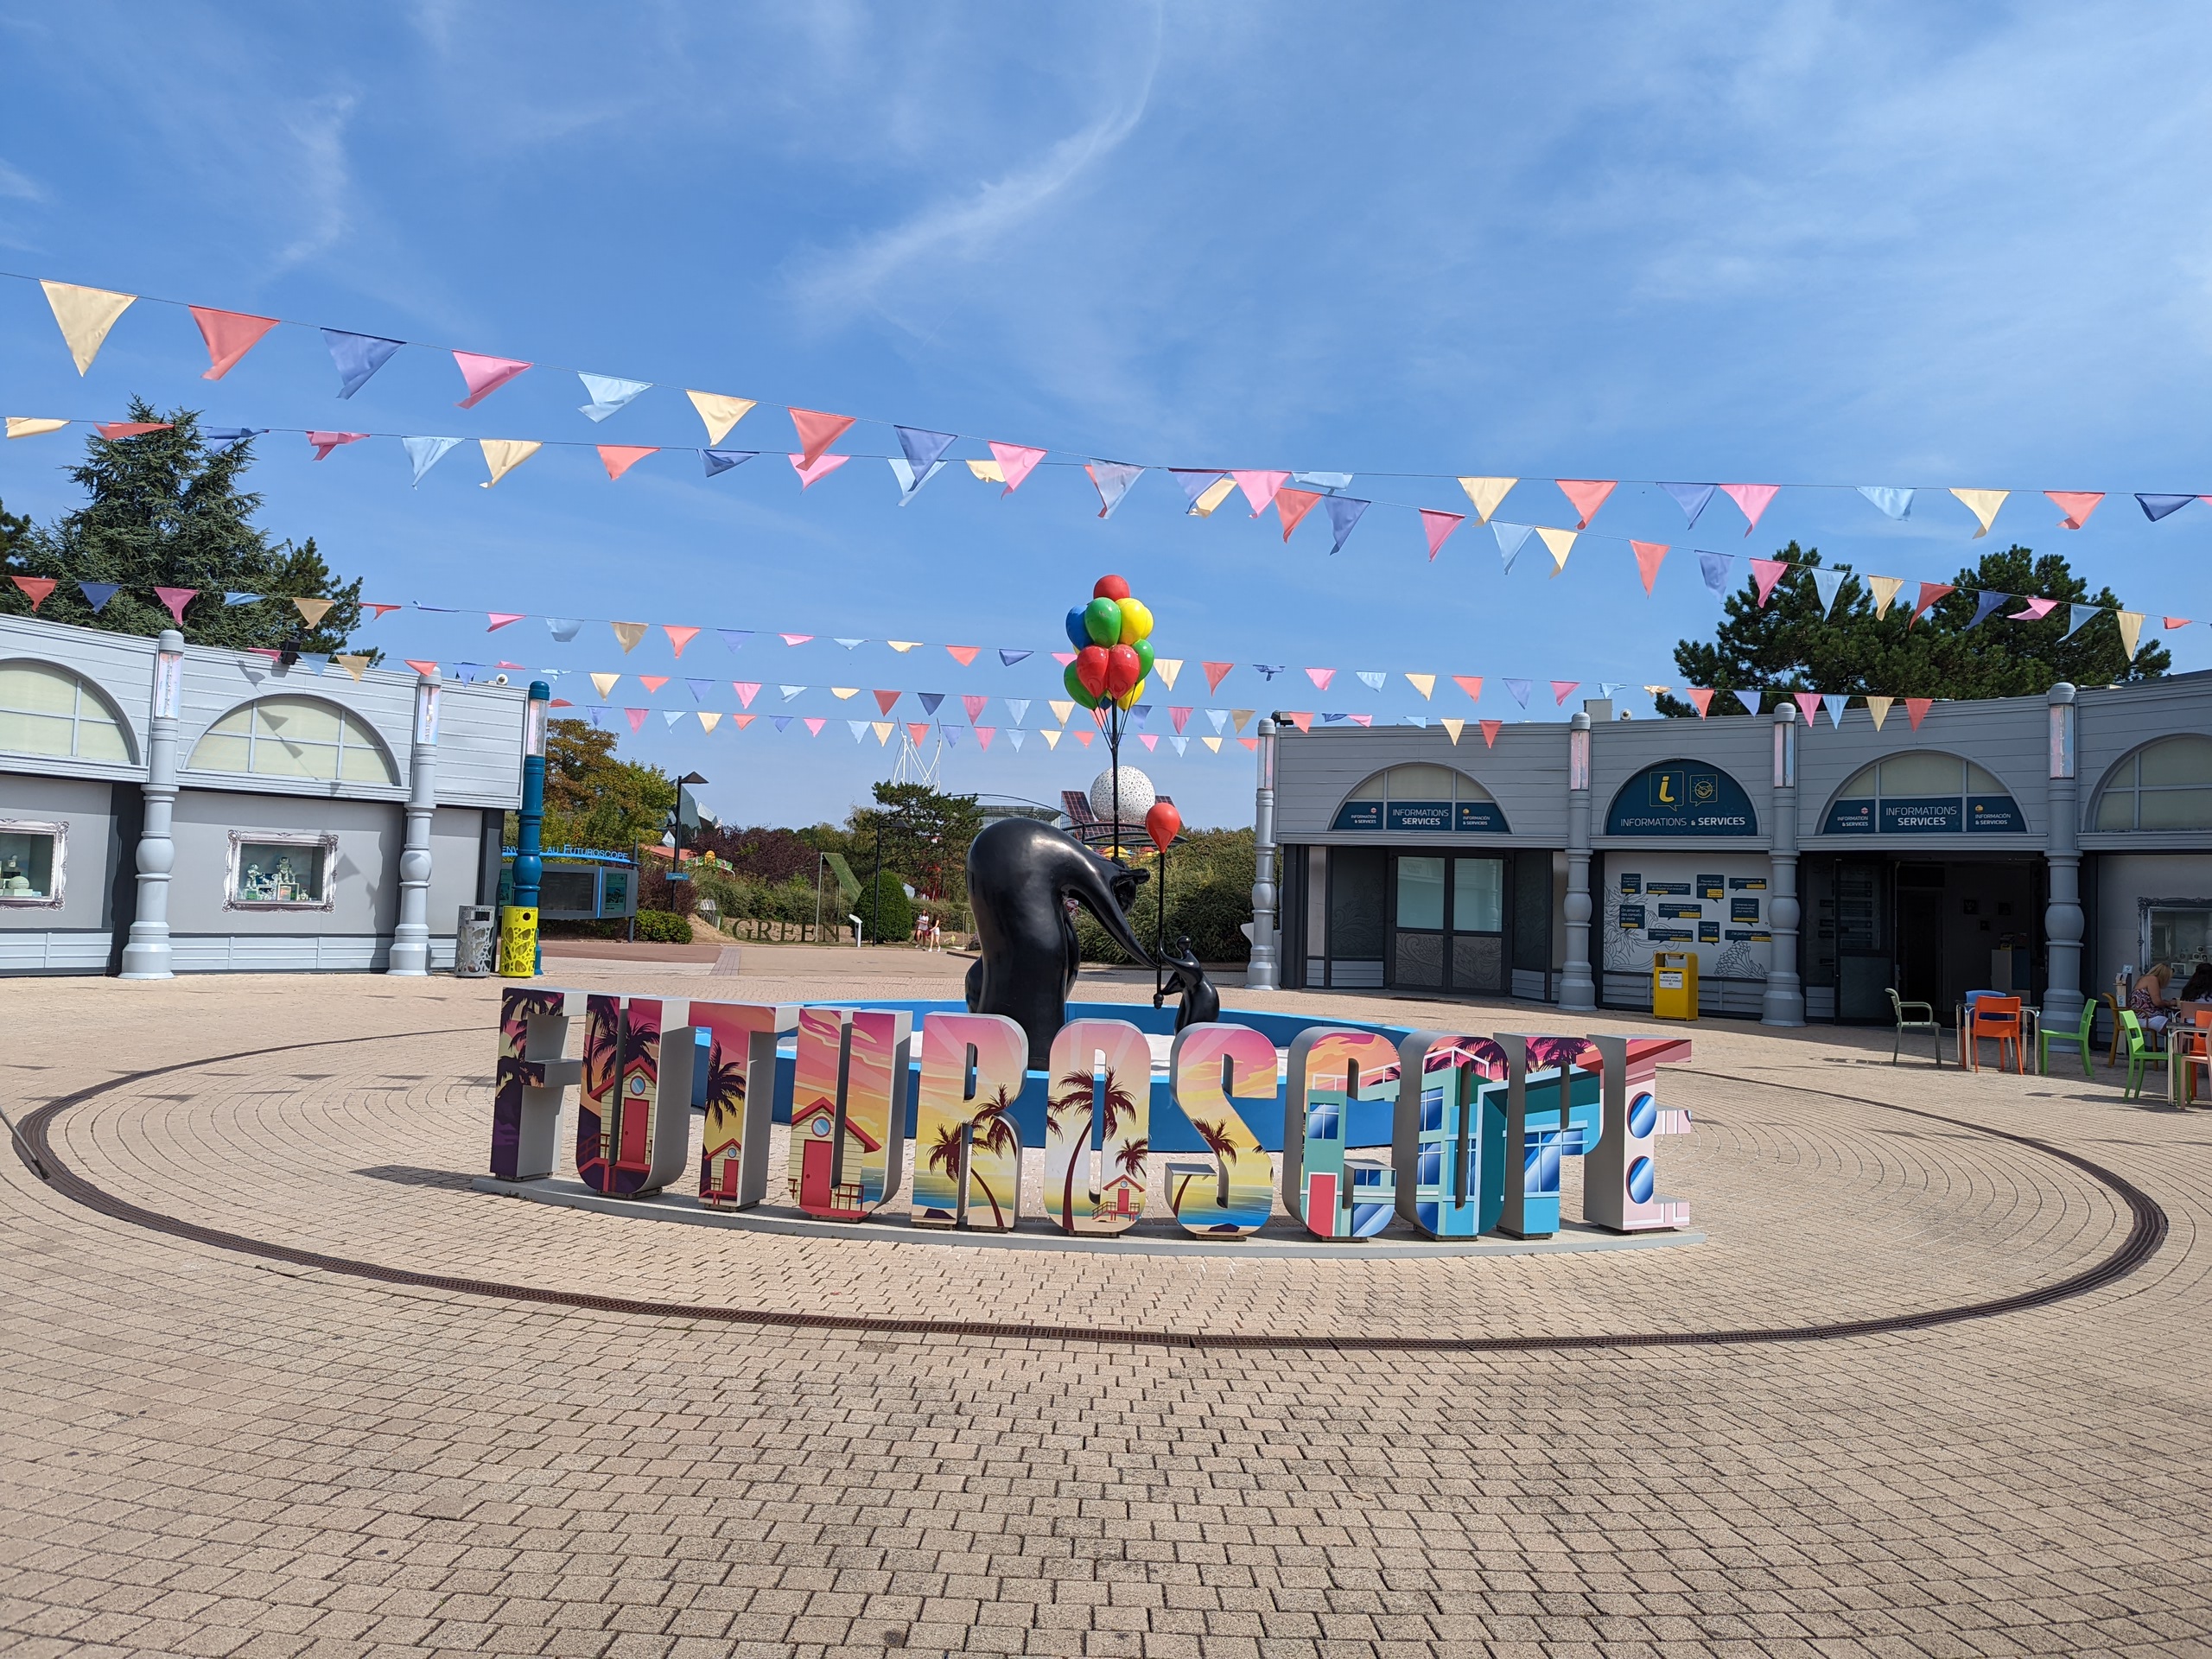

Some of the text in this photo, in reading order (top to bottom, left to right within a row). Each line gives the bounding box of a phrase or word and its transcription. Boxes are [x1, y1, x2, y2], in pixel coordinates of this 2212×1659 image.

[1392, 808, 1449, 817] INFORMATIONS
[1885, 805, 1957, 817] INFORMATIONS
[1402, 817, 1440, 826] SERVICES
[1620, 817, 1688, 828] INFORMATIONS
[1698, 817, 1745, 826] SERVICES
[1897, 817, 1947, 827] SERVICES
[547, 845, 559, 855] AU
[563, 843, 629, 861] FUTUROSCOPE
[733, 918, 840, 943] GREEN
[490, 987, 1692, 1239] FUTUROSCOPE
